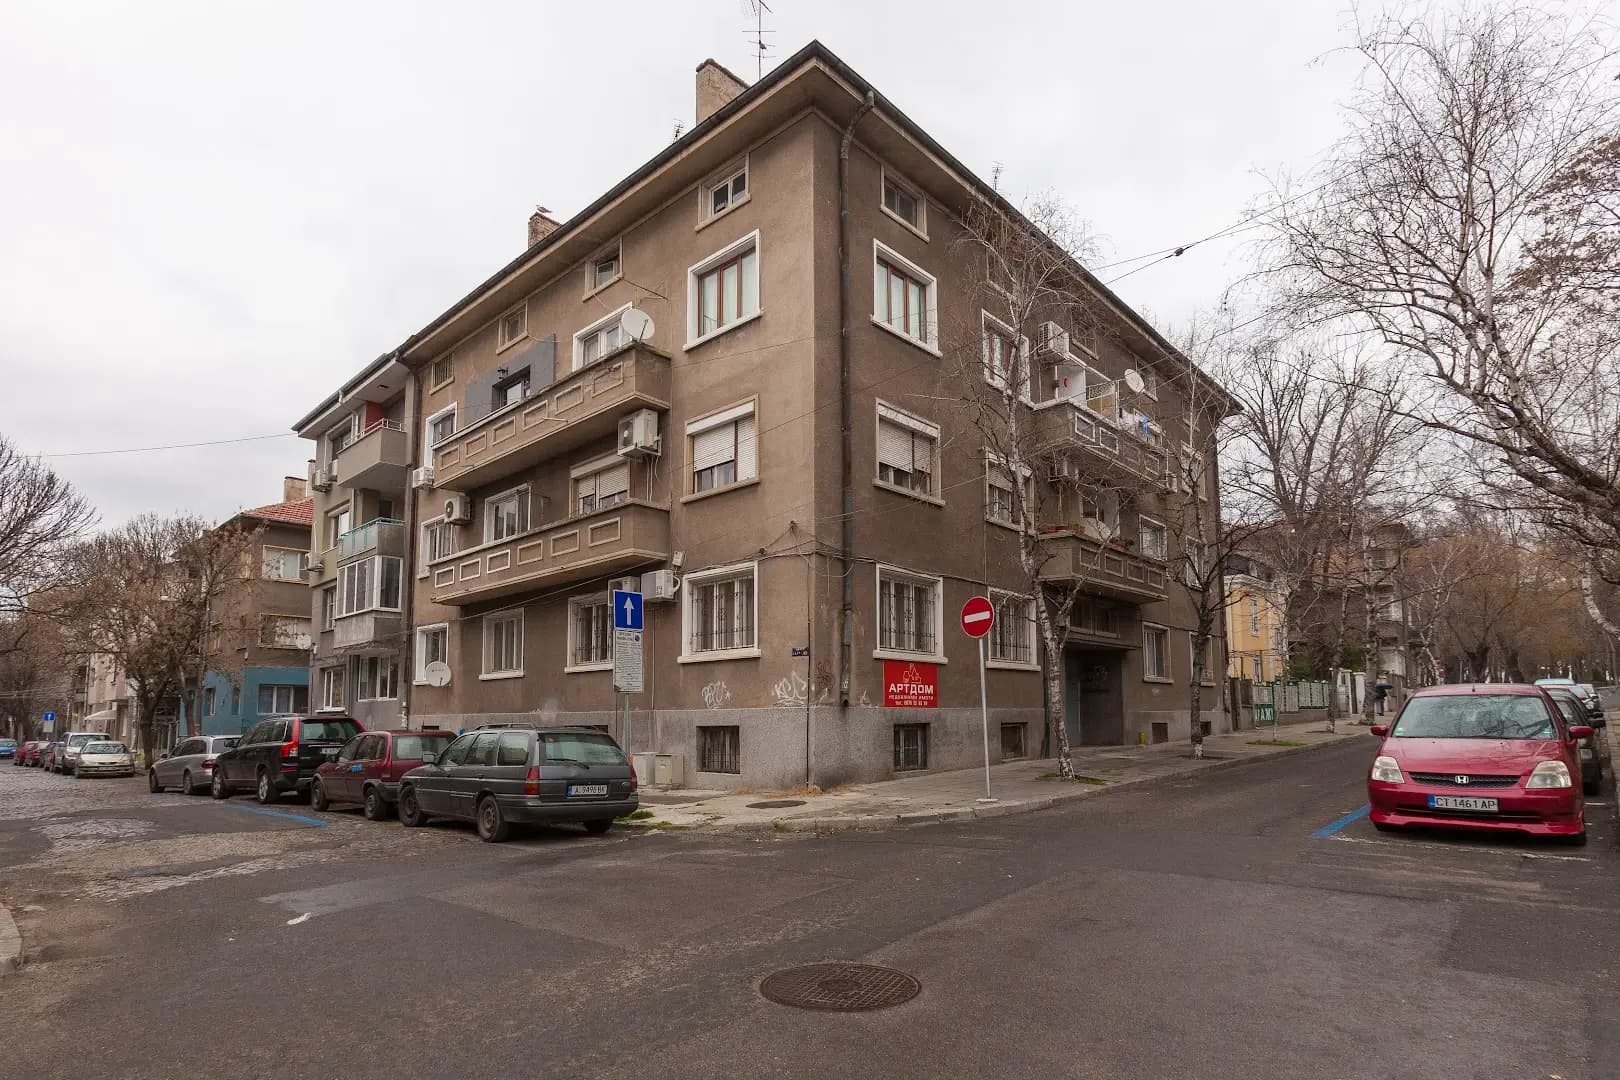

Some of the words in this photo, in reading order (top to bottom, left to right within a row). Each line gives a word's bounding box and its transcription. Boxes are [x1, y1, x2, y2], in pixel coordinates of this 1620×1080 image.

[889, 683, 934, 696] АРТДОМ
[1436, 797, 1450, 807] CT
[1453, 798, 1478, 809] 1461
[1480, 800, 1497, 809] AP
